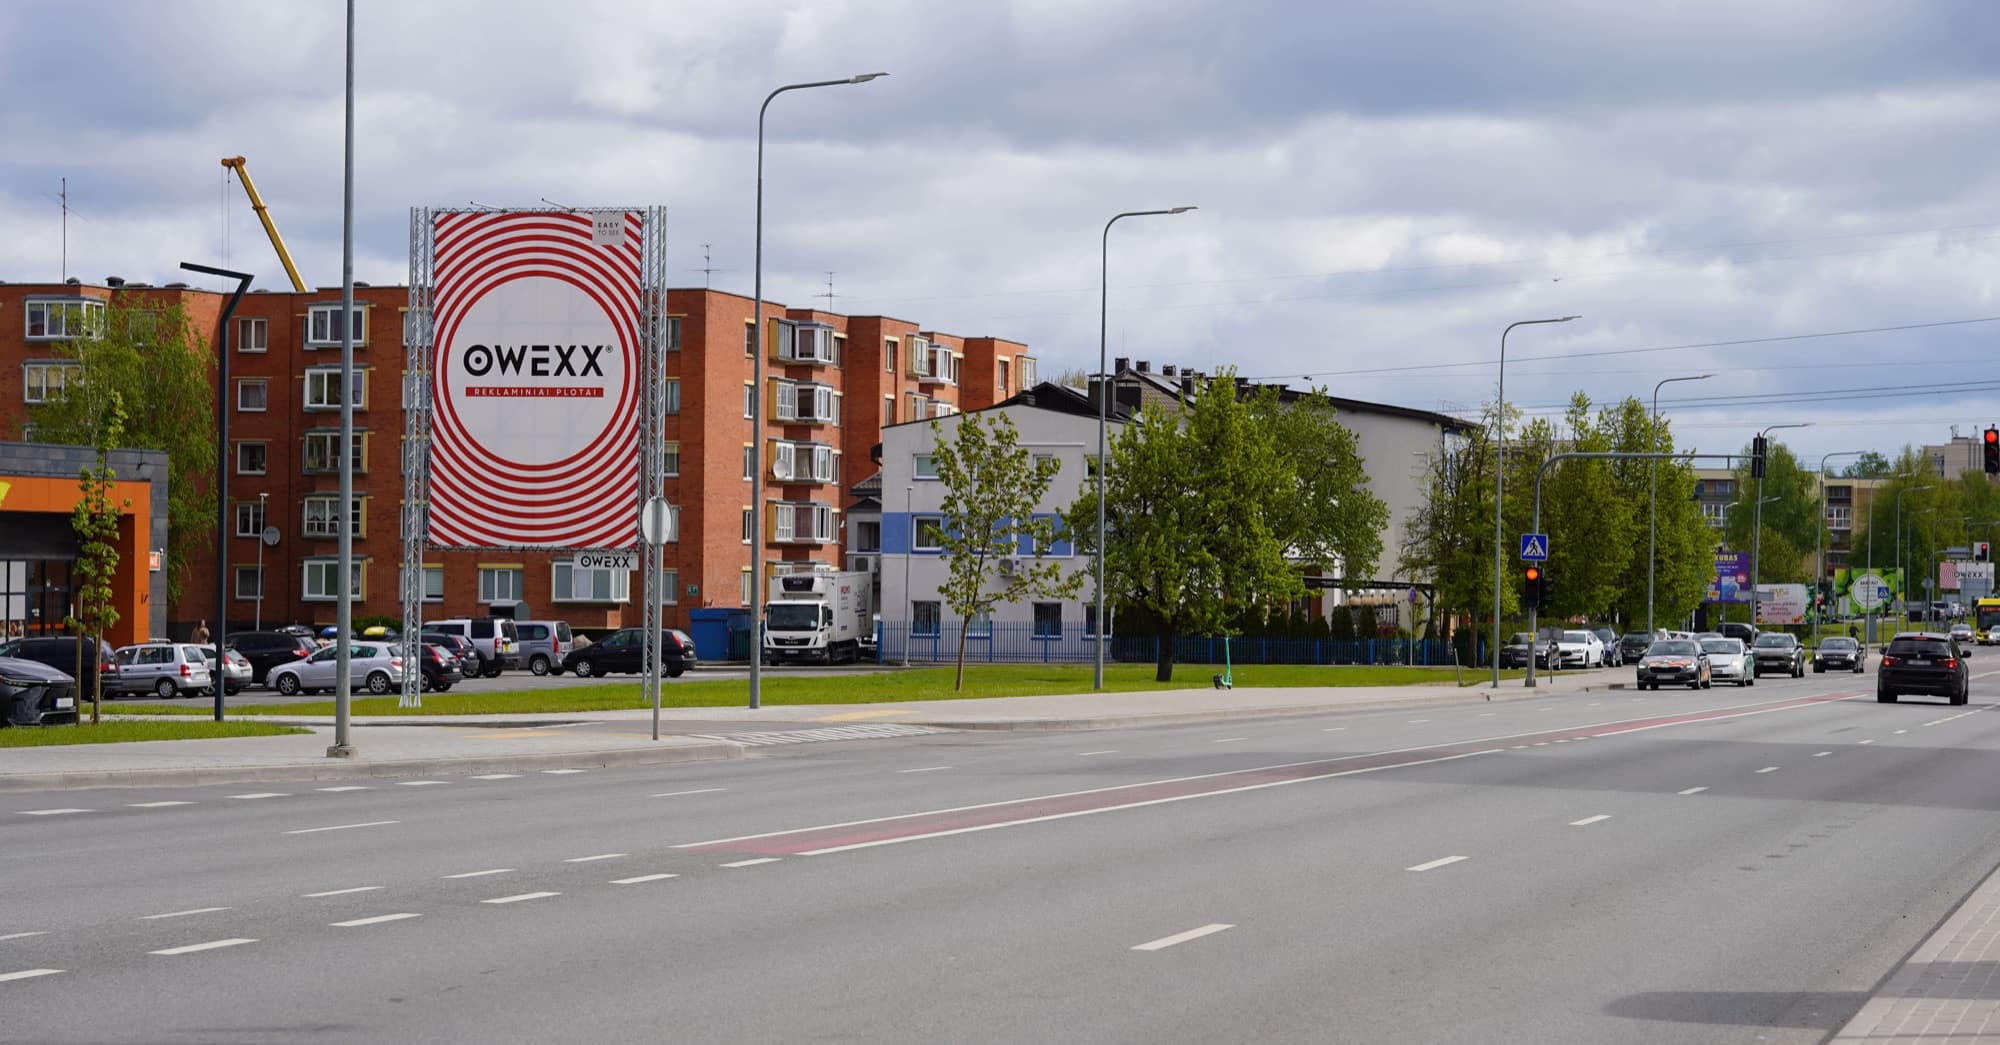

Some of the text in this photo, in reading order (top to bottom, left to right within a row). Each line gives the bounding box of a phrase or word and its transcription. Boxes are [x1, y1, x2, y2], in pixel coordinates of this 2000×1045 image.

[474, 388, 597, 396] REKLAMINIAI PLOTAI
[580, 555, 630, 568] OWEXX
